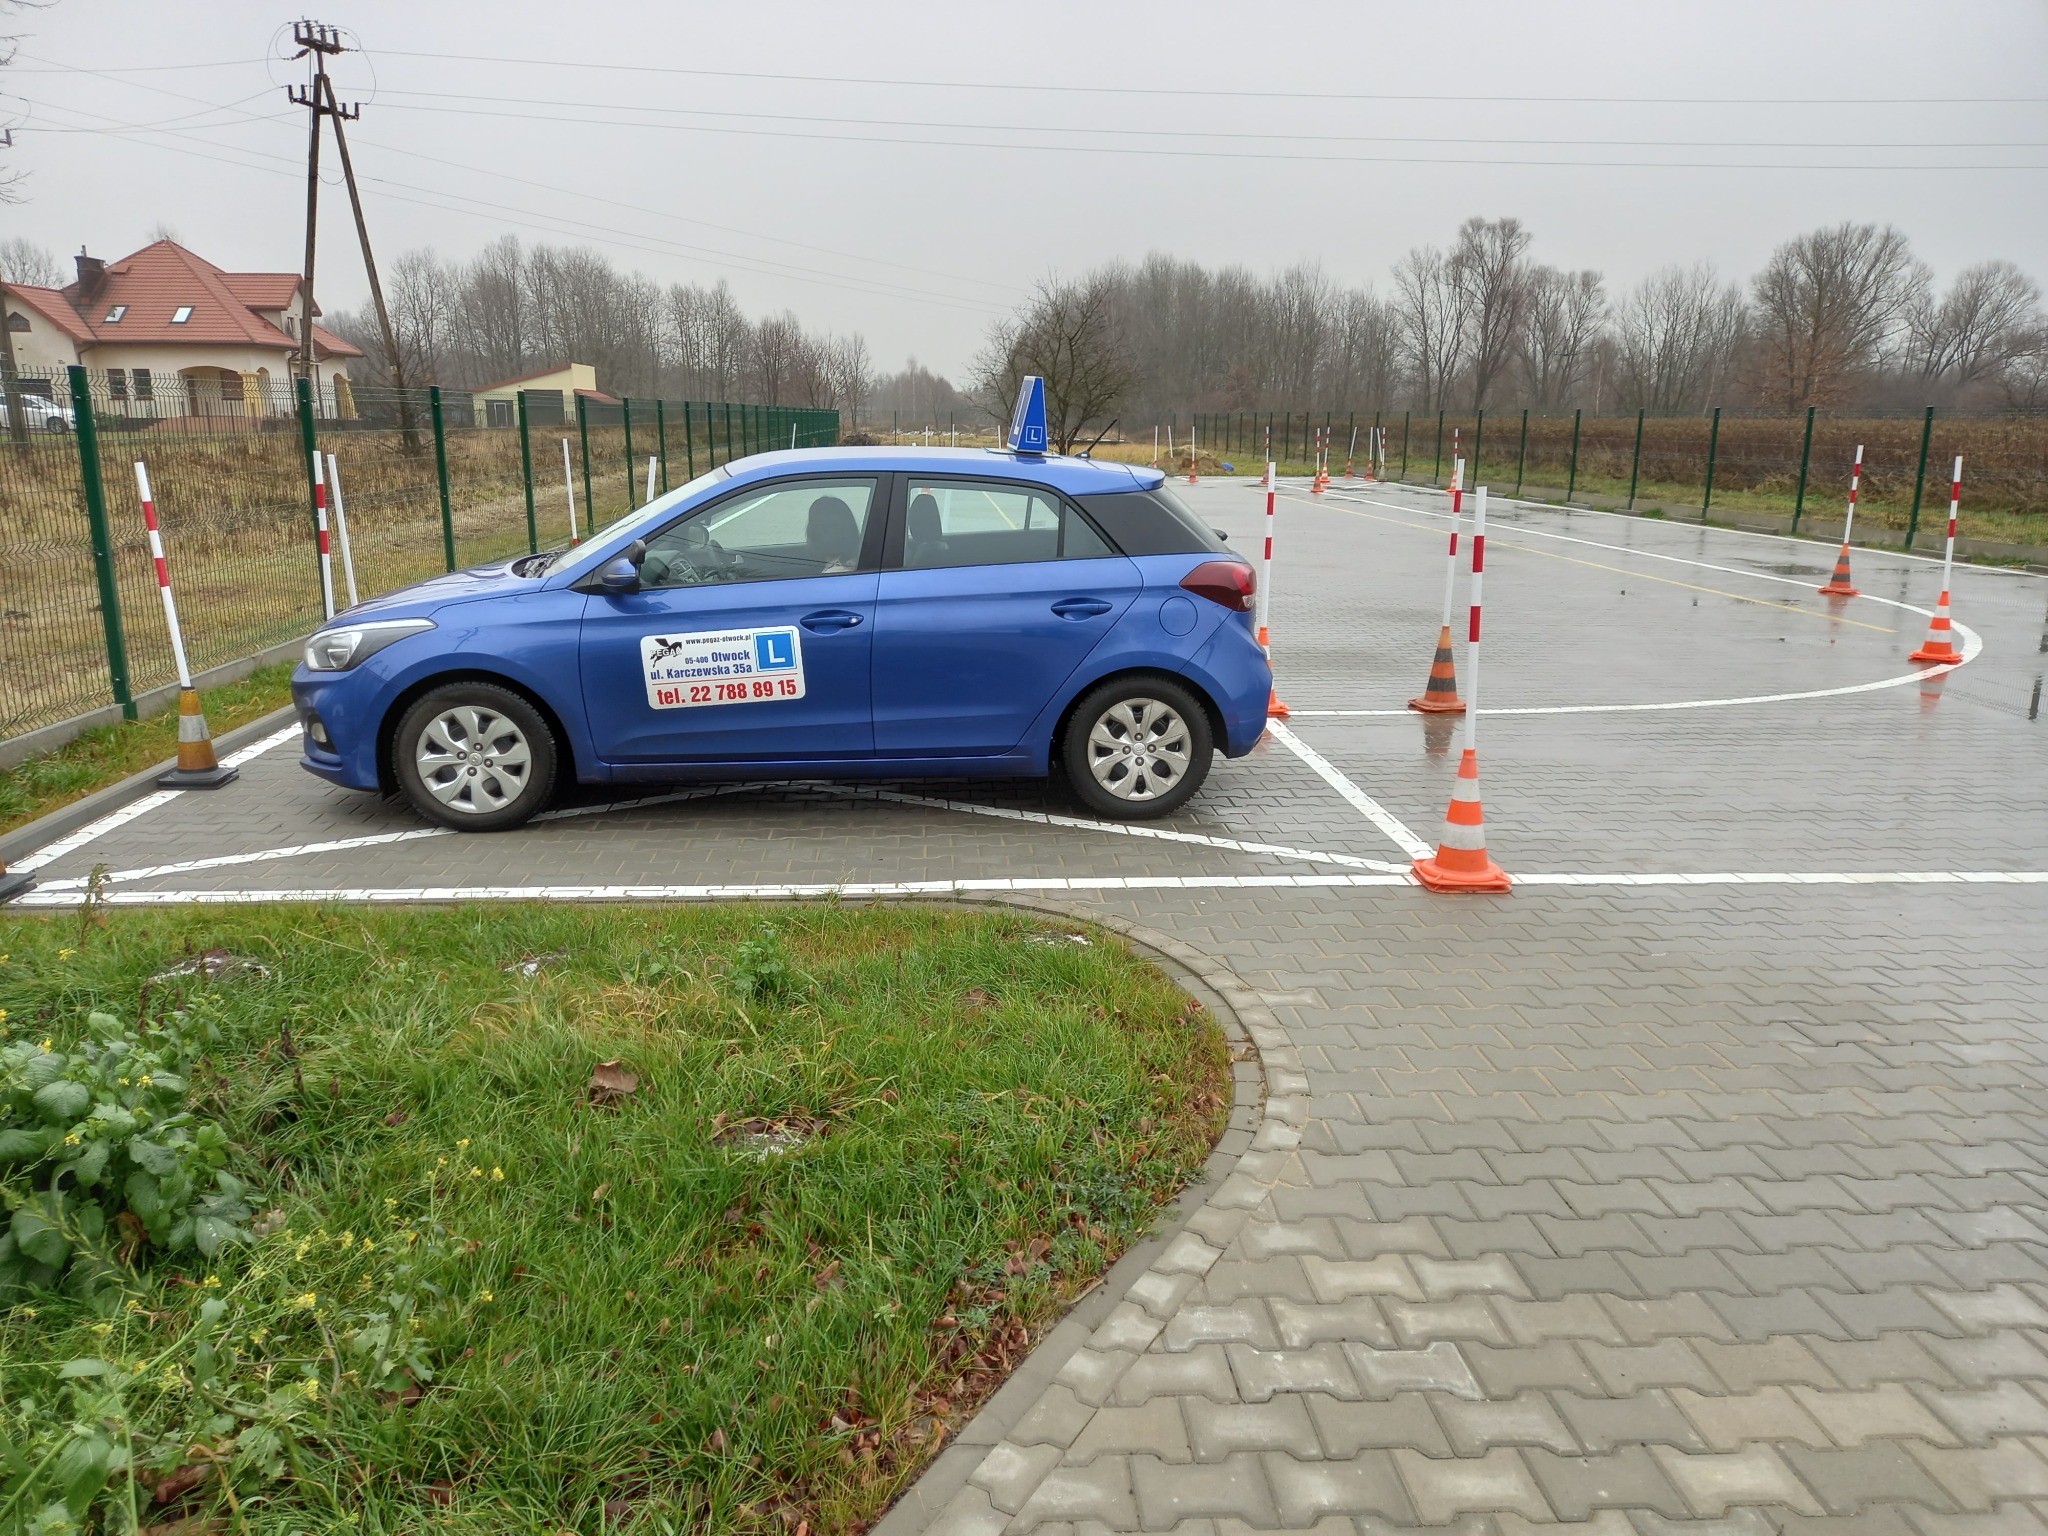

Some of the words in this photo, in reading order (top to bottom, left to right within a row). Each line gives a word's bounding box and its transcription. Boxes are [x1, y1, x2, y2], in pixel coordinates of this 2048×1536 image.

[1031, 429, 1038, 440] L
[685, 634, 751, 645] www.pegaz-otwock.pl
[685, 656, 709, 665] 05-400
[711, 650, 751, 662] Otwock
[767, 639, 786, 663] L
[650, 670, 664, 680] ul.
[666, 664, 730, 679] Karczewska
[733, 663, 752, 674] 35a
[657, 688, 686, 705] tel.
[690, 686, 712, 703] 22
[715, 683, 747, 700] 788
[752, 681, 774, 698] 89
[778, 679, 797, 696] 15
